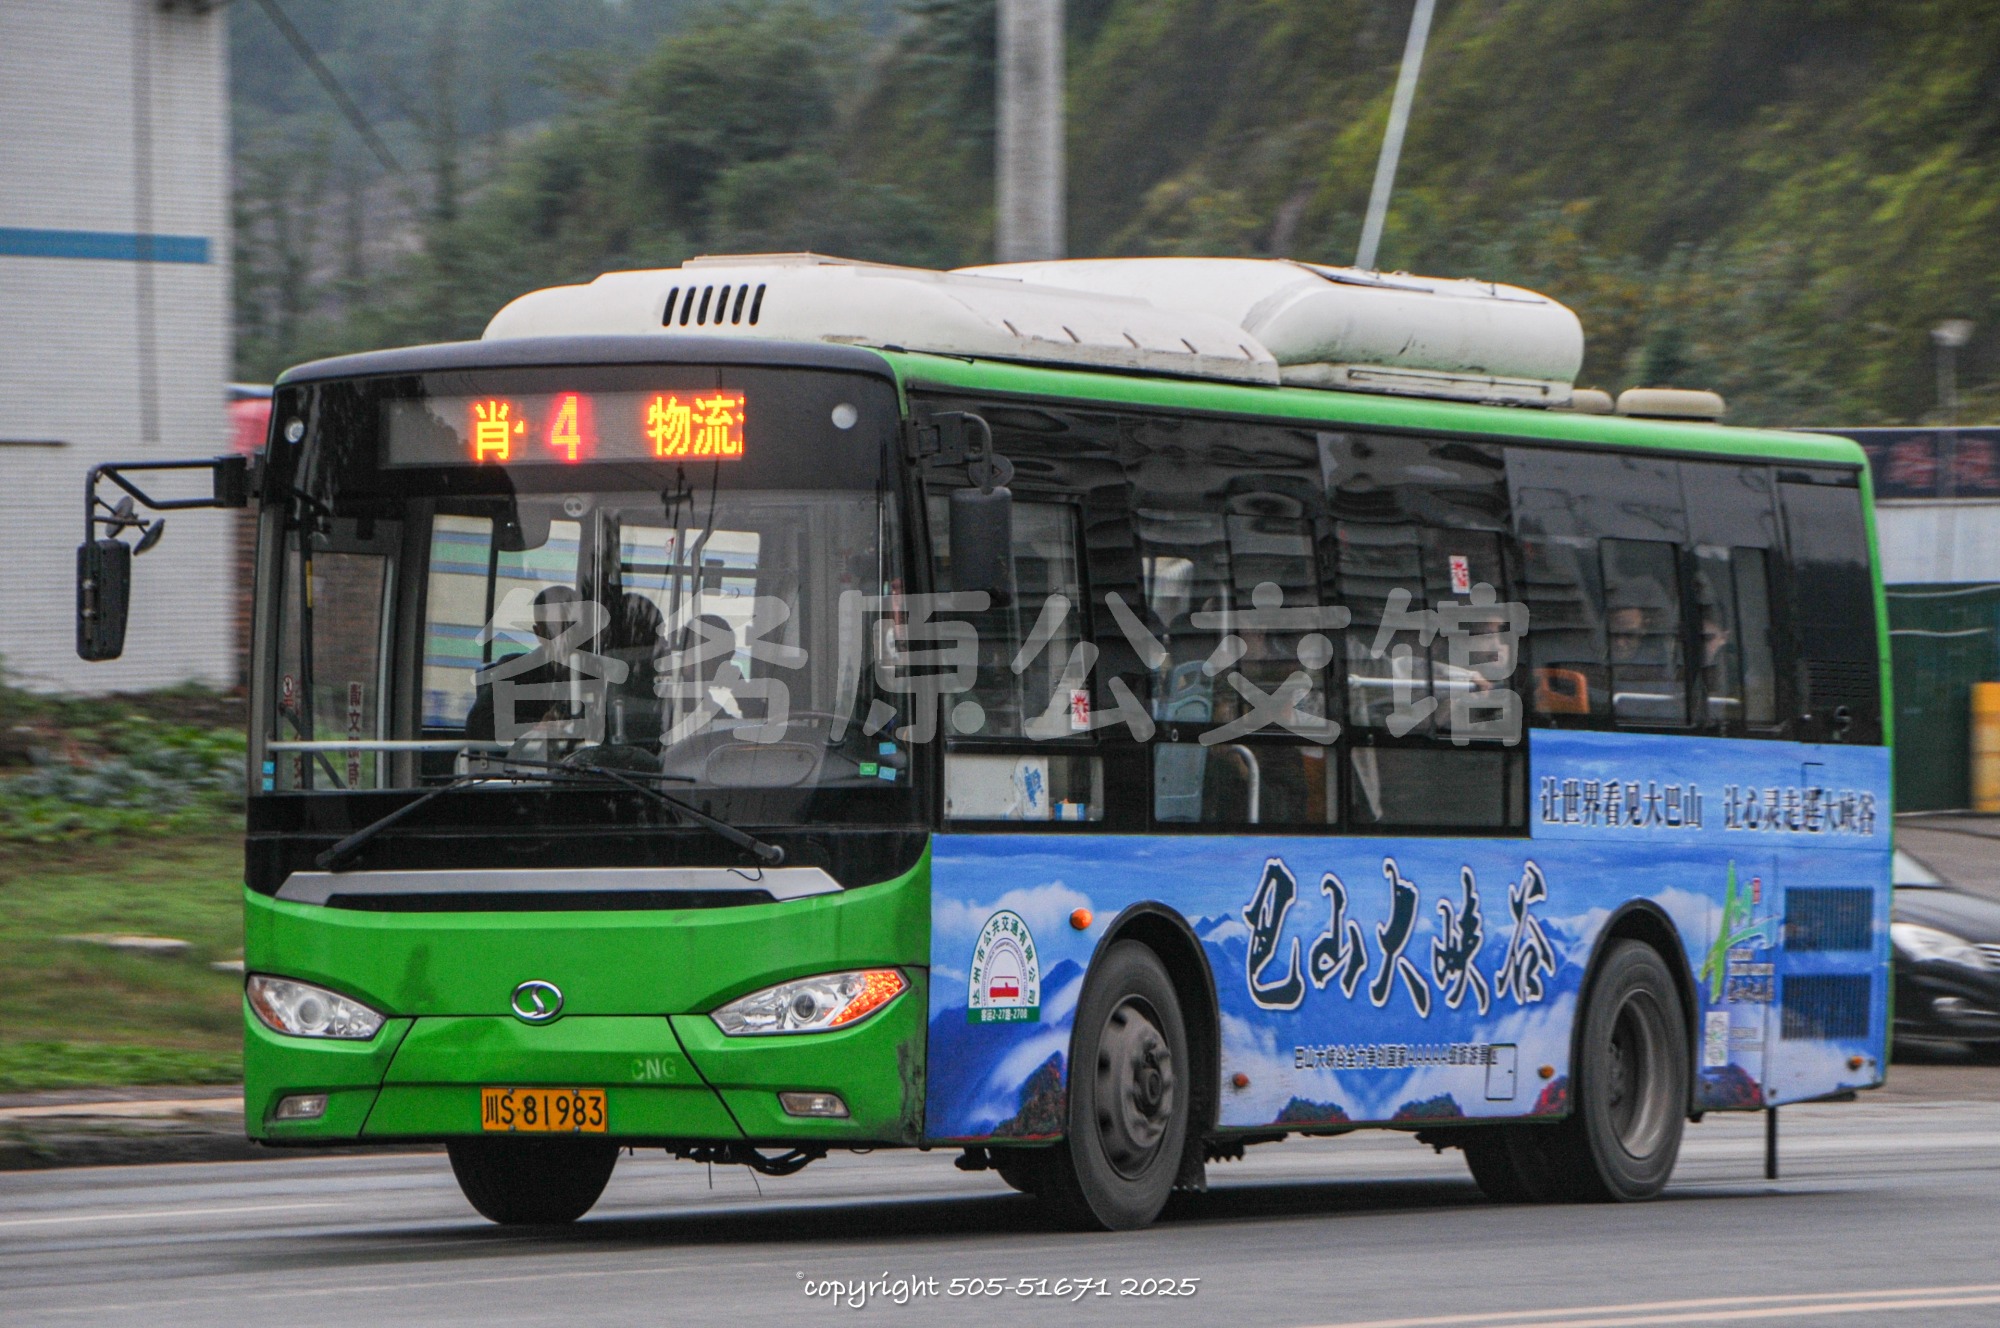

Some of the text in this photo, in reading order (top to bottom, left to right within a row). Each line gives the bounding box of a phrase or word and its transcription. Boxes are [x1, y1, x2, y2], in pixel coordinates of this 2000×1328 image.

[474, 394, 744, 462] 肖 4 物流
[1540, 776, 1703, 829] 让世界看见大巴山
[1242, 857, 1555, 1018] 巴山大峡谷
[631, 1057, 677, 1081] CNG
